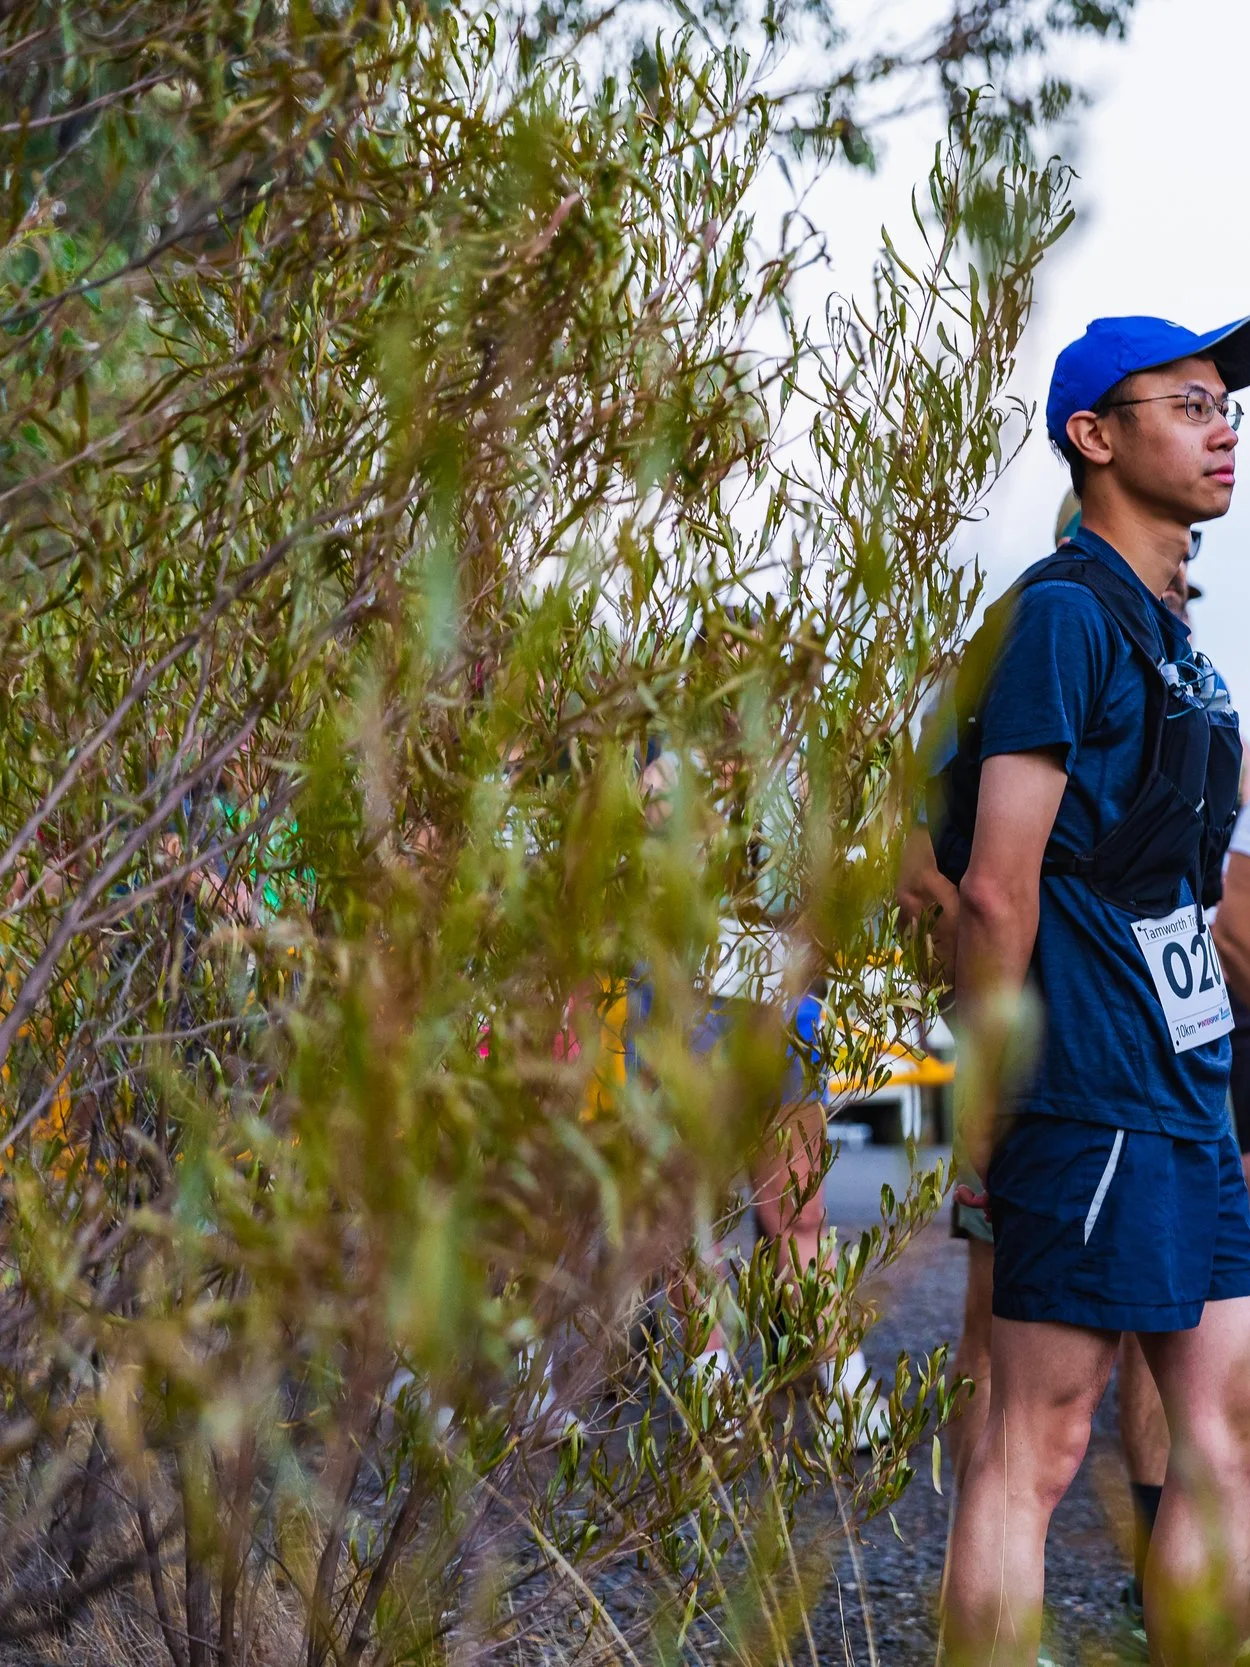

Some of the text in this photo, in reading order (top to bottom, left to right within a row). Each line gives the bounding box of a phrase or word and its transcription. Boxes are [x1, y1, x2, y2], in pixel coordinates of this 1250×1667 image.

[1143, 917, 1187, 940] Tamworth
[1162, 931, 1221, 999] 020
[1176, 1023, 1196, 1038] 10km
